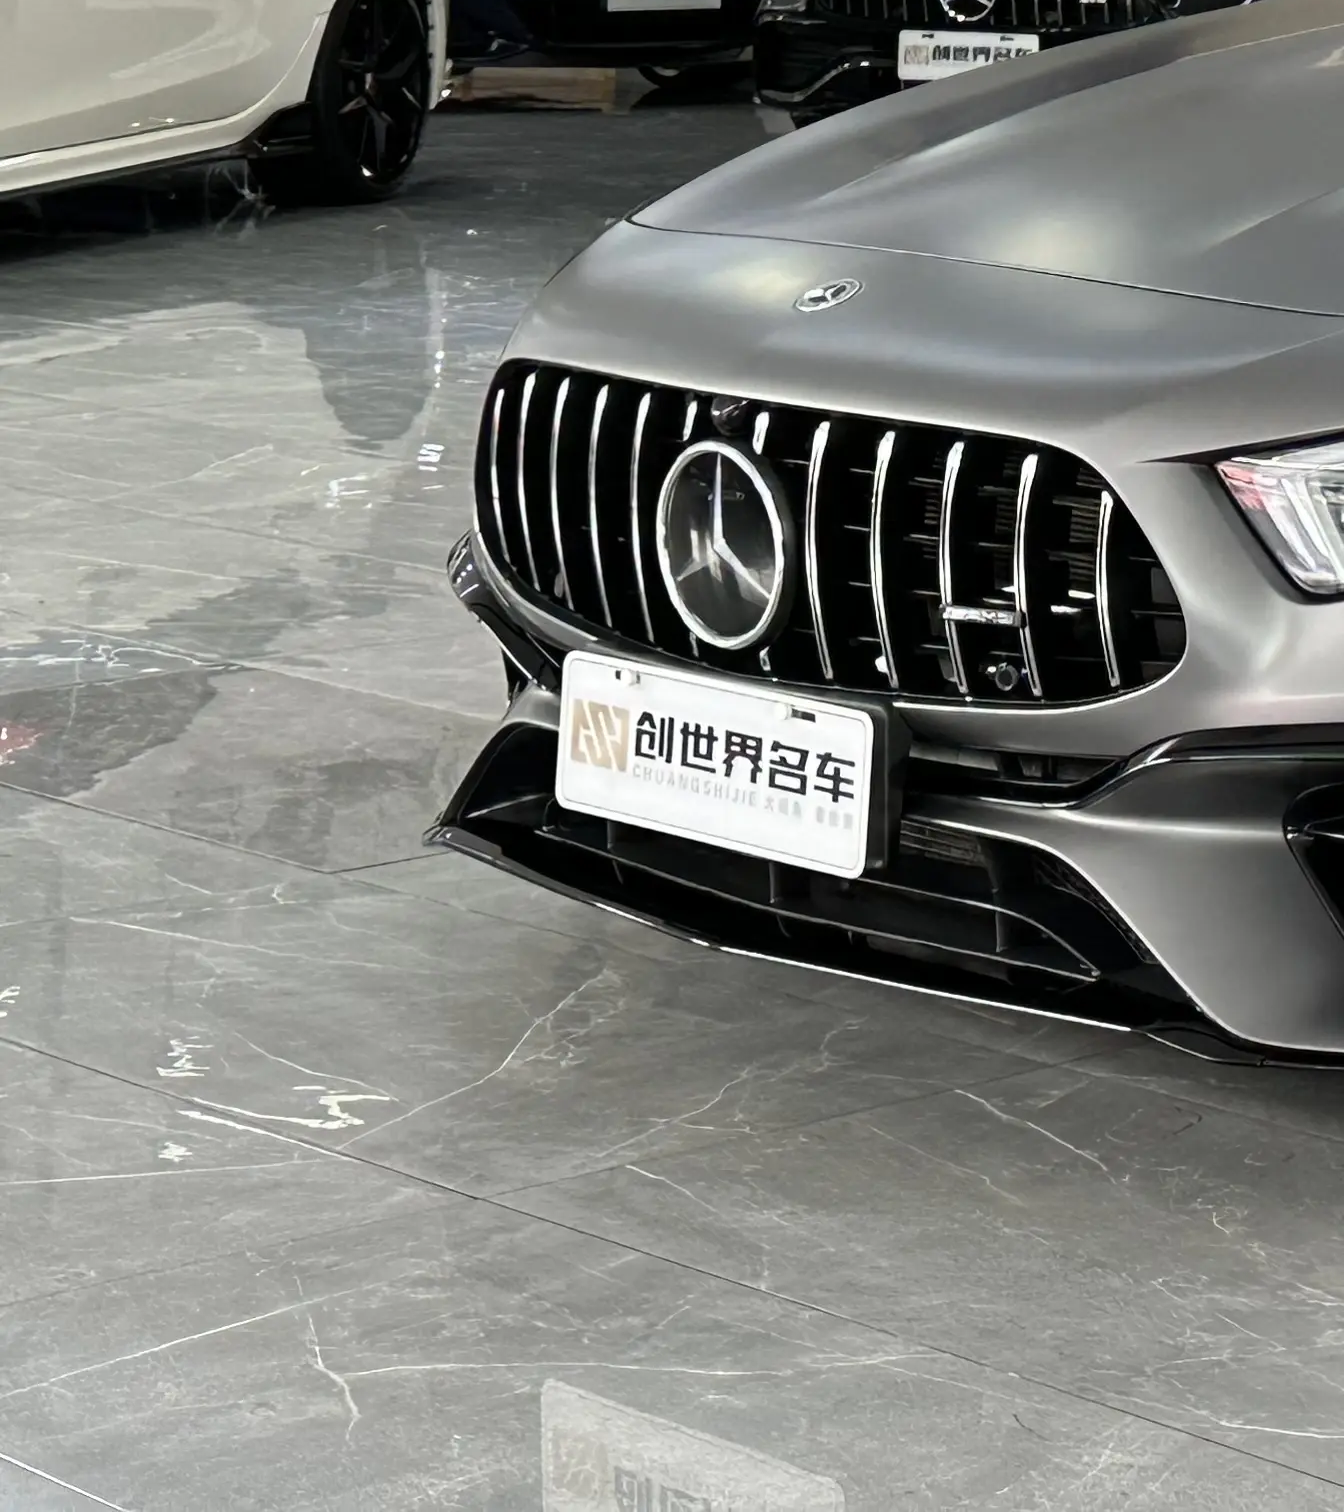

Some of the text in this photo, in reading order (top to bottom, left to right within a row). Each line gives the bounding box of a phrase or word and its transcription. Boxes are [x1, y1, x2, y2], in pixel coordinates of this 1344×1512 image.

[634, 710, 856, 804] 创世界名车
